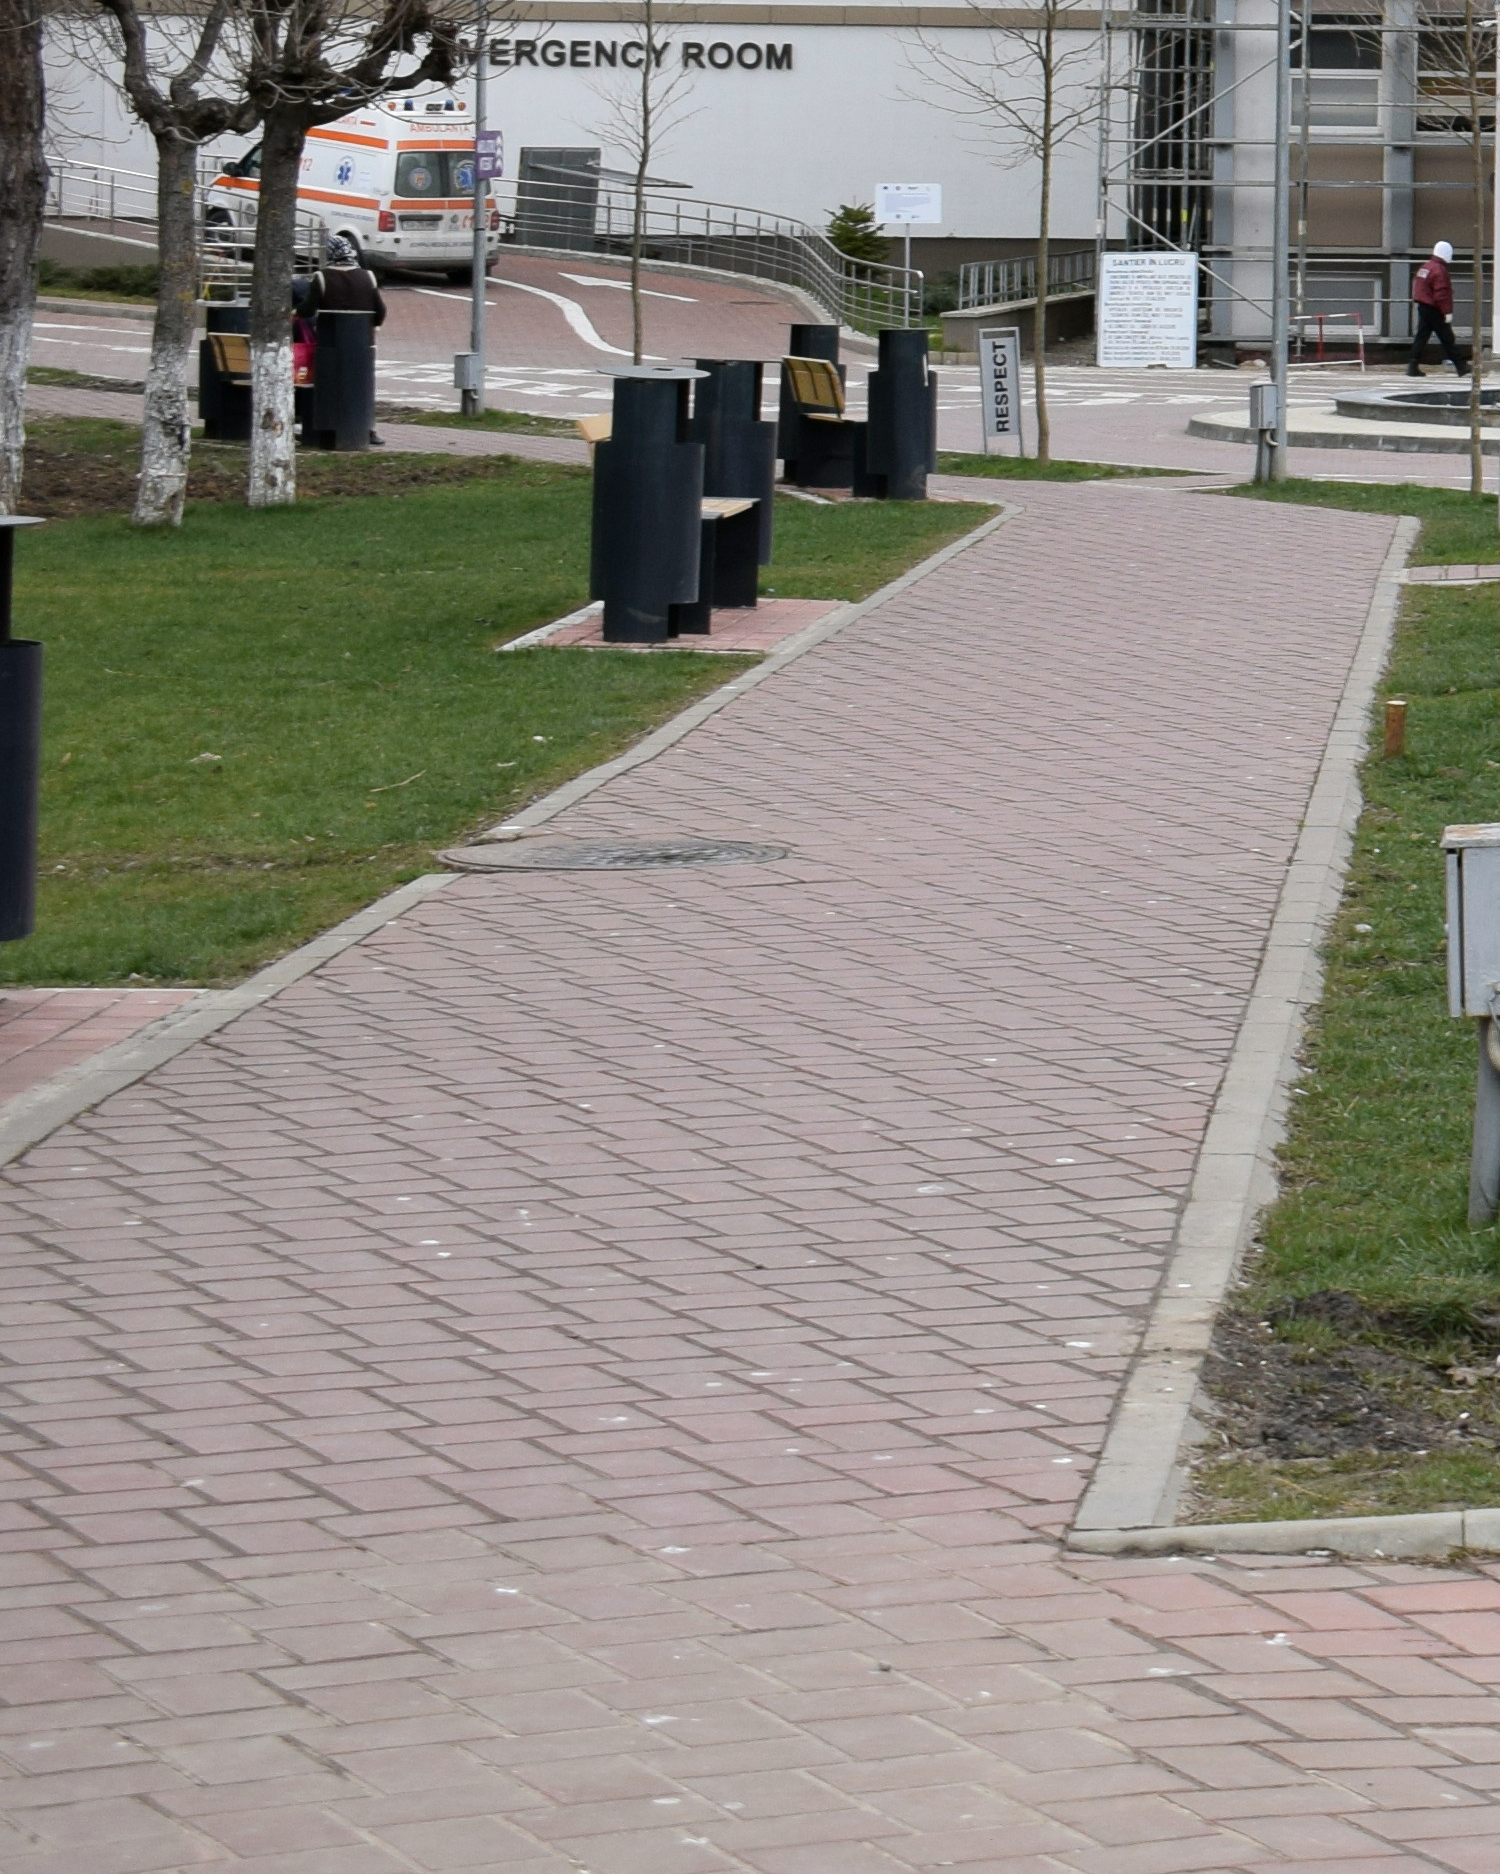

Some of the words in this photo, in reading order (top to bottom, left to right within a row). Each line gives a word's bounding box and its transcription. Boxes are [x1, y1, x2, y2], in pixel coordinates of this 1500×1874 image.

[457, 39, 671, 68] MERGENCY
[683, 42, 793, 70] ROOM
[992, 341, 1010, 433] RESPECT
